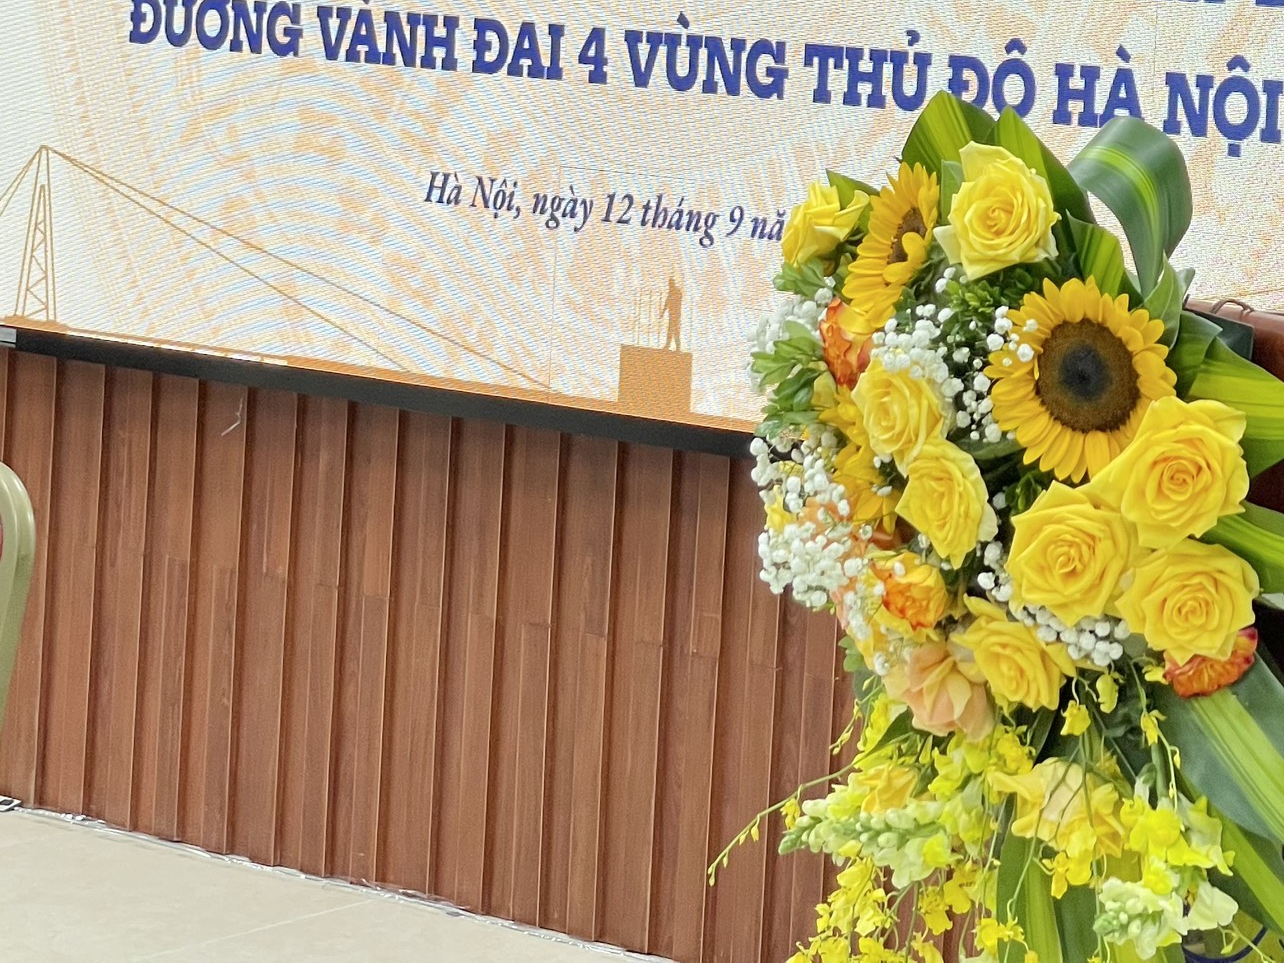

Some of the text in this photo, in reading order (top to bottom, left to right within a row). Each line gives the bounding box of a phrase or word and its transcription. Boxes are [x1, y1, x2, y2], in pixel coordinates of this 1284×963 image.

[472, 18, 564, 79] ĐAI
[579, 28, 607, 84] 4
[625, 13, 788, 99] VÙNG
[804, 30, 931, 111] THỦ
[948, 39, 1035, 117] ĐÔ
[1053, 46, 1142, 127] HÀ
[1163, 56, 1282, 157] NỘI
[423, 170, 787, 247] Hà Nội, ngày 12 tháng 9 nă
